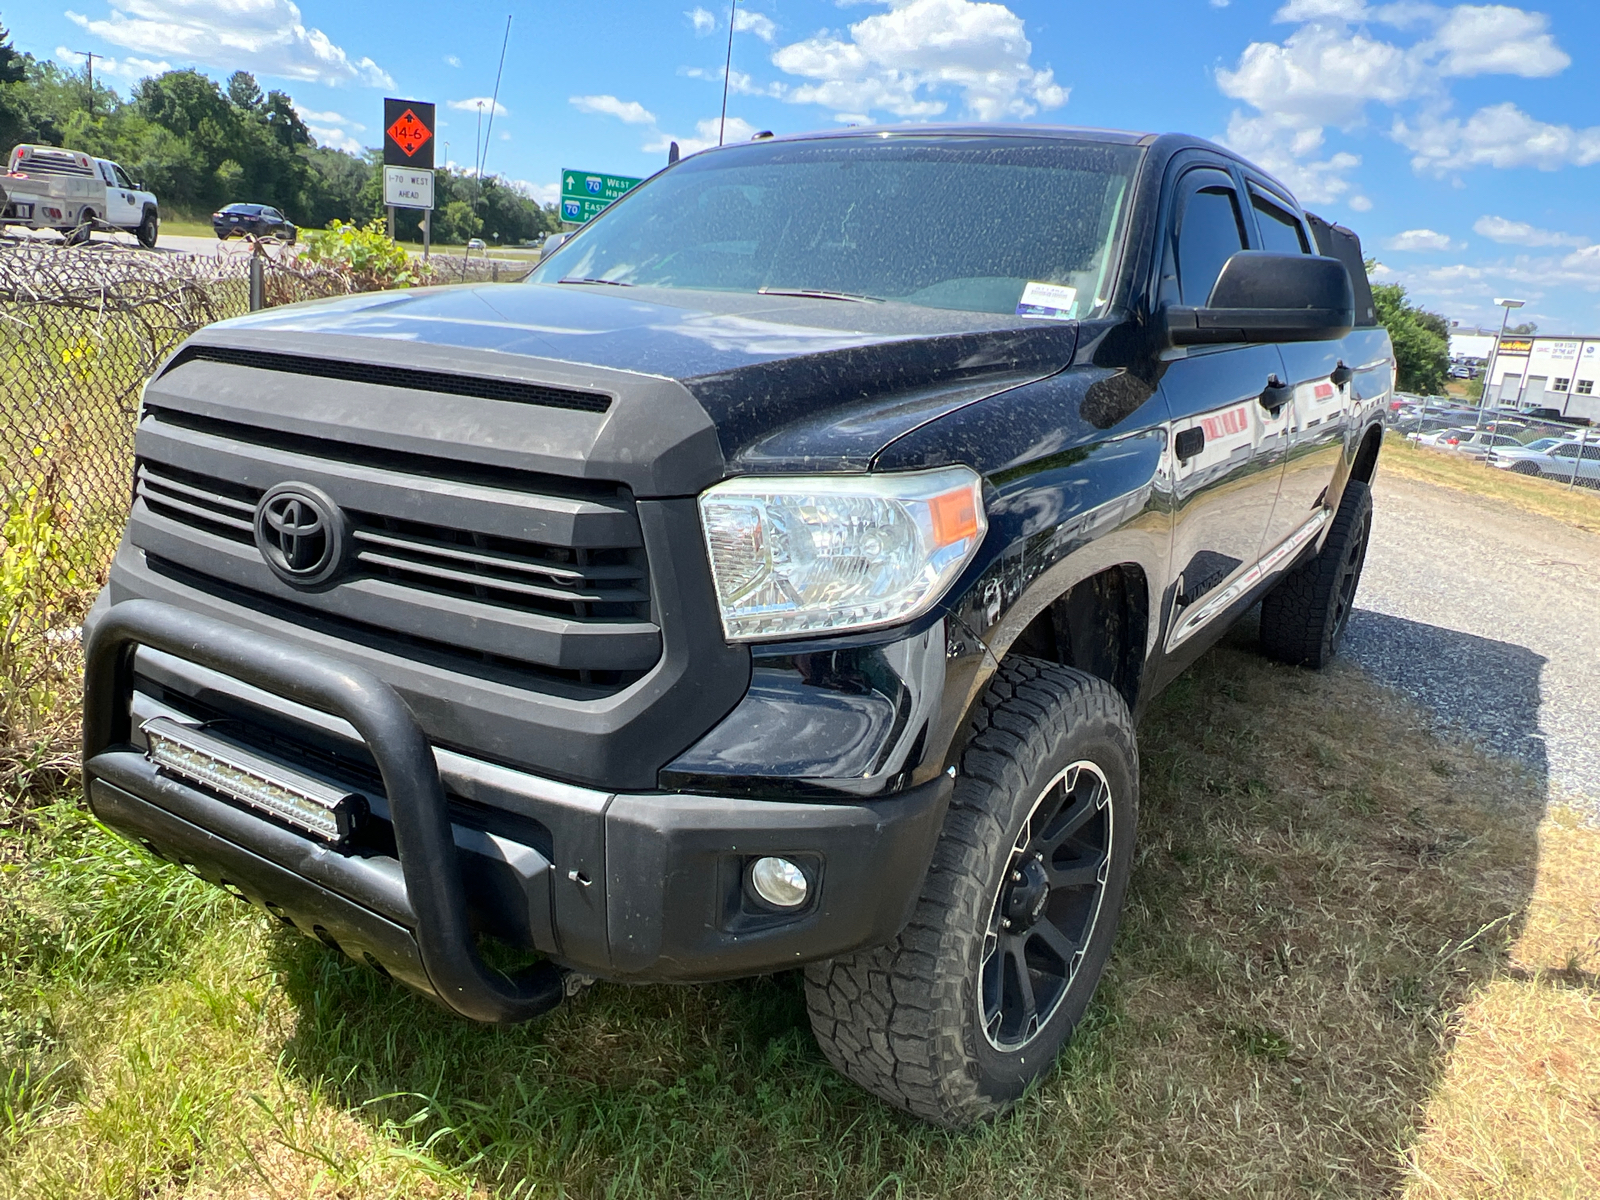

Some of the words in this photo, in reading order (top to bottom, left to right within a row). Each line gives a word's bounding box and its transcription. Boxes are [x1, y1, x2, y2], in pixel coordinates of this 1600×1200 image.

[411, 177, 429, 186] WEST
[588, 181, 600, 191] 70
[607, 178, 629, 188] WEST
[398, 190, 420, 199] AHEAD
[566, 204, 578, 215] 70
